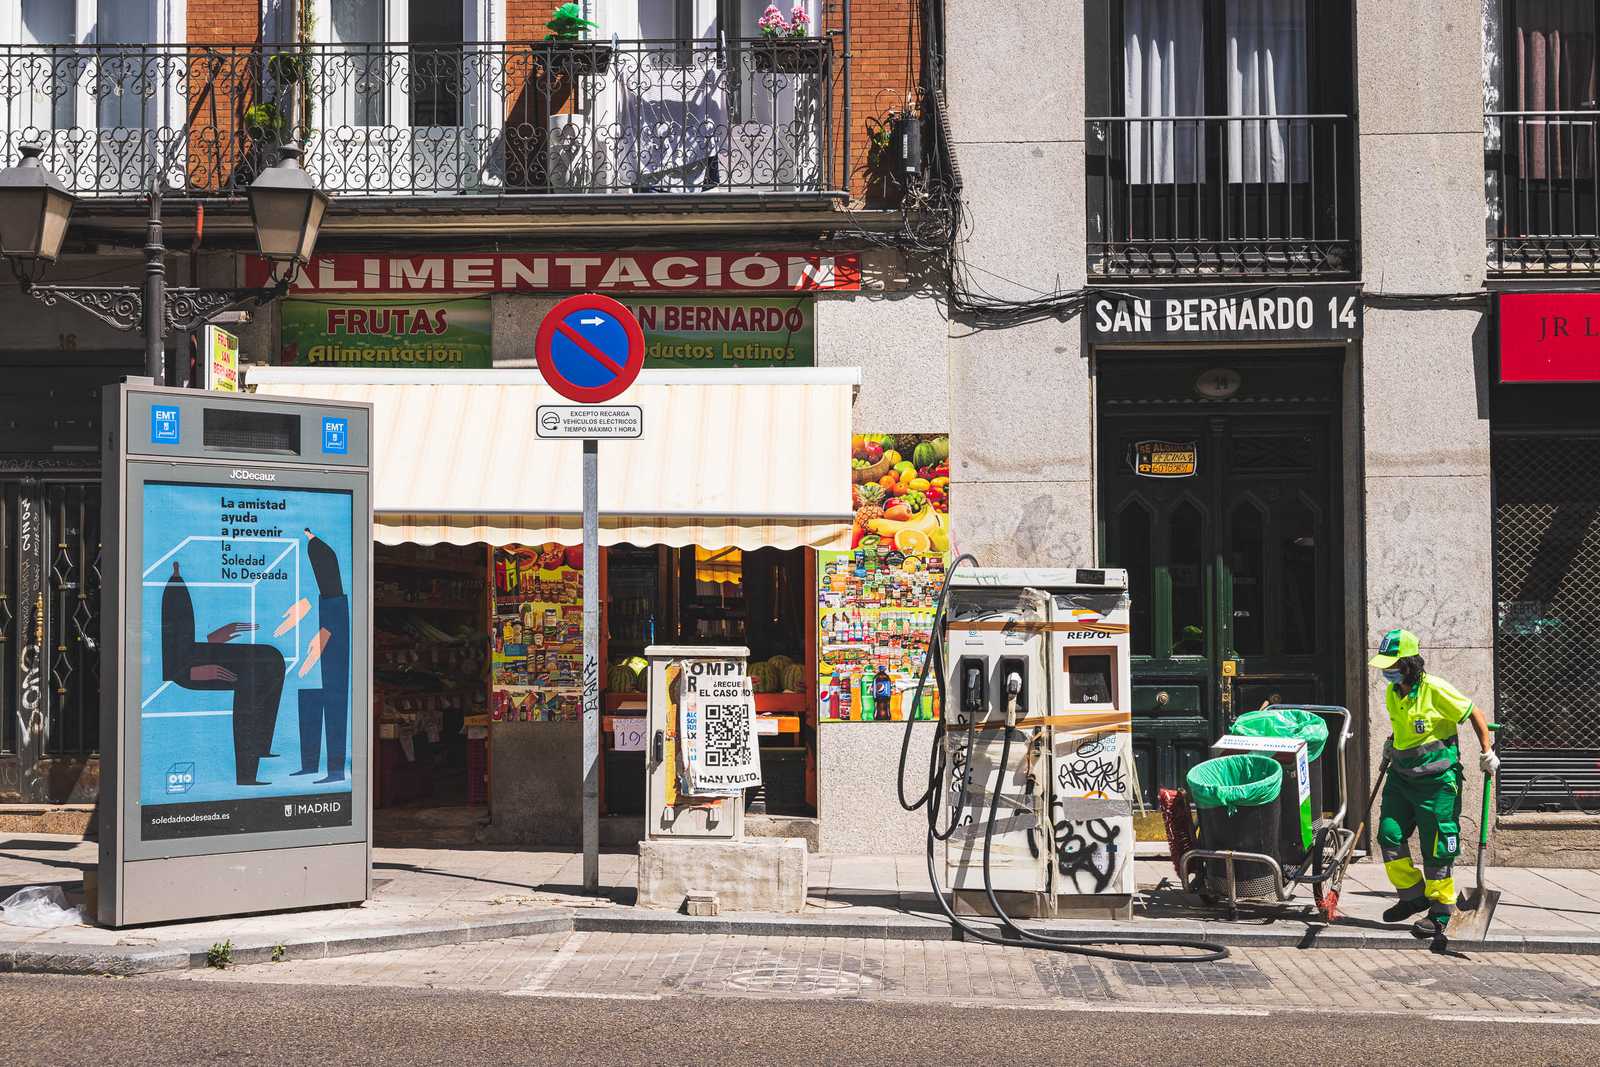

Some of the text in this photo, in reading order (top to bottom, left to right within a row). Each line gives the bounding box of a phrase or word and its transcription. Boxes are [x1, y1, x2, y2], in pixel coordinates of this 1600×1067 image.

[664, 305, 804, 333] BERNARDO
[1095, 296, 1357, 332] SAN BERNARDO 14
[326, 307, 450, 336] FRUTAS
[1536, 316, 1568, 342] JR
[307, 343, 464, 363] Alimentación
[645, 342, 796, 361] ductos Latinos
[155, 411, 177, 420] EMT
[325, 422, 344, 432] EMT
[230, 470, 276, 482] JCDecaux
[221, 496, 286, 510] La amistad
[221, 512, 258, 525] ayuda
[221, 526, 284, 539] a prevenir
[221, 540, 232, 552] la
[221, 553, 265, 566] Soledad
[221, 568, 288, 580] No Deseada
[1067, 631, 1112, 640] REPSOL
[699, 689, 711, 697] EL
[713, 689, 738, 697] CASO
[168, 773, 193, 784] 010
[699, 775, 723, 784] HAN
[298, 801, 341, 815] MADRID
[151, 812, 231, 825] soledadnodeseada.es
